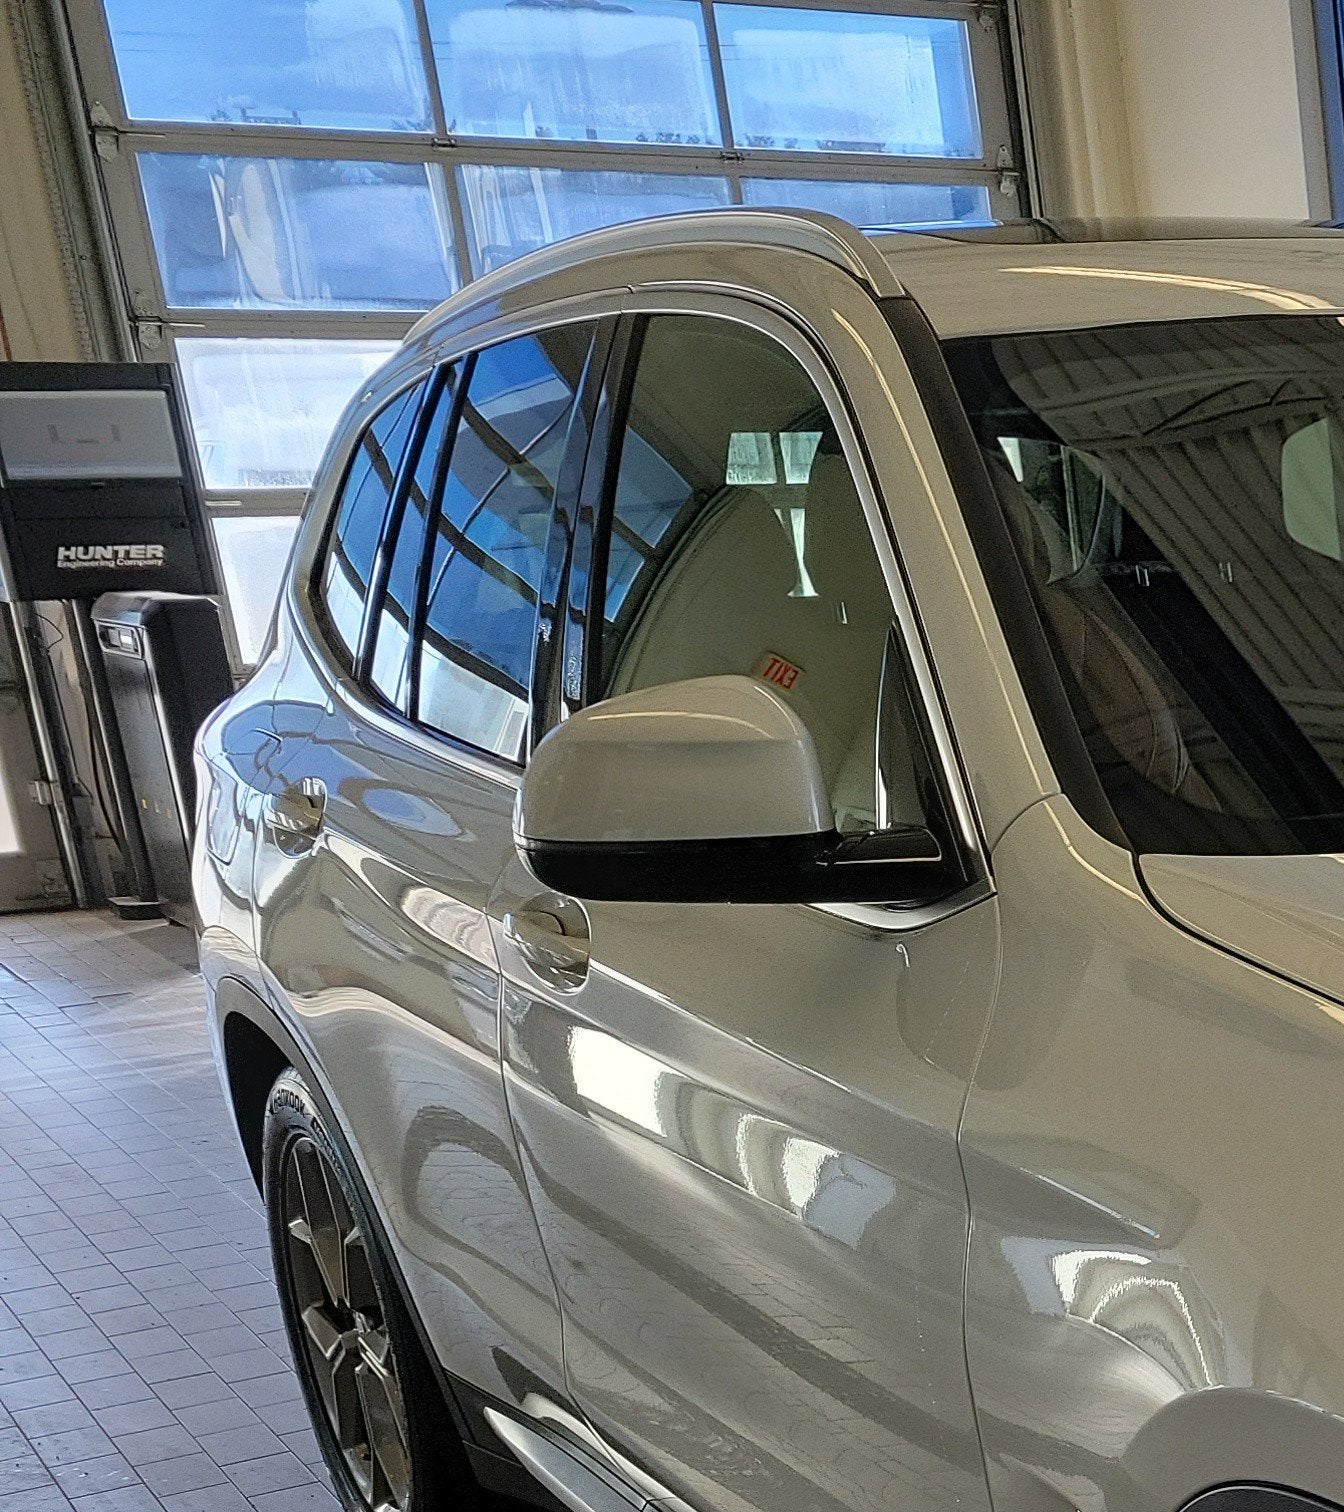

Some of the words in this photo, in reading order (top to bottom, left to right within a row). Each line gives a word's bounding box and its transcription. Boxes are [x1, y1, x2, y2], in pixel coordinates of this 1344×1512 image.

[57, 545, 164, 560] HUNTER
[57, 560, 115, 569] Engineering
[116, 558, 164, 566] Company
